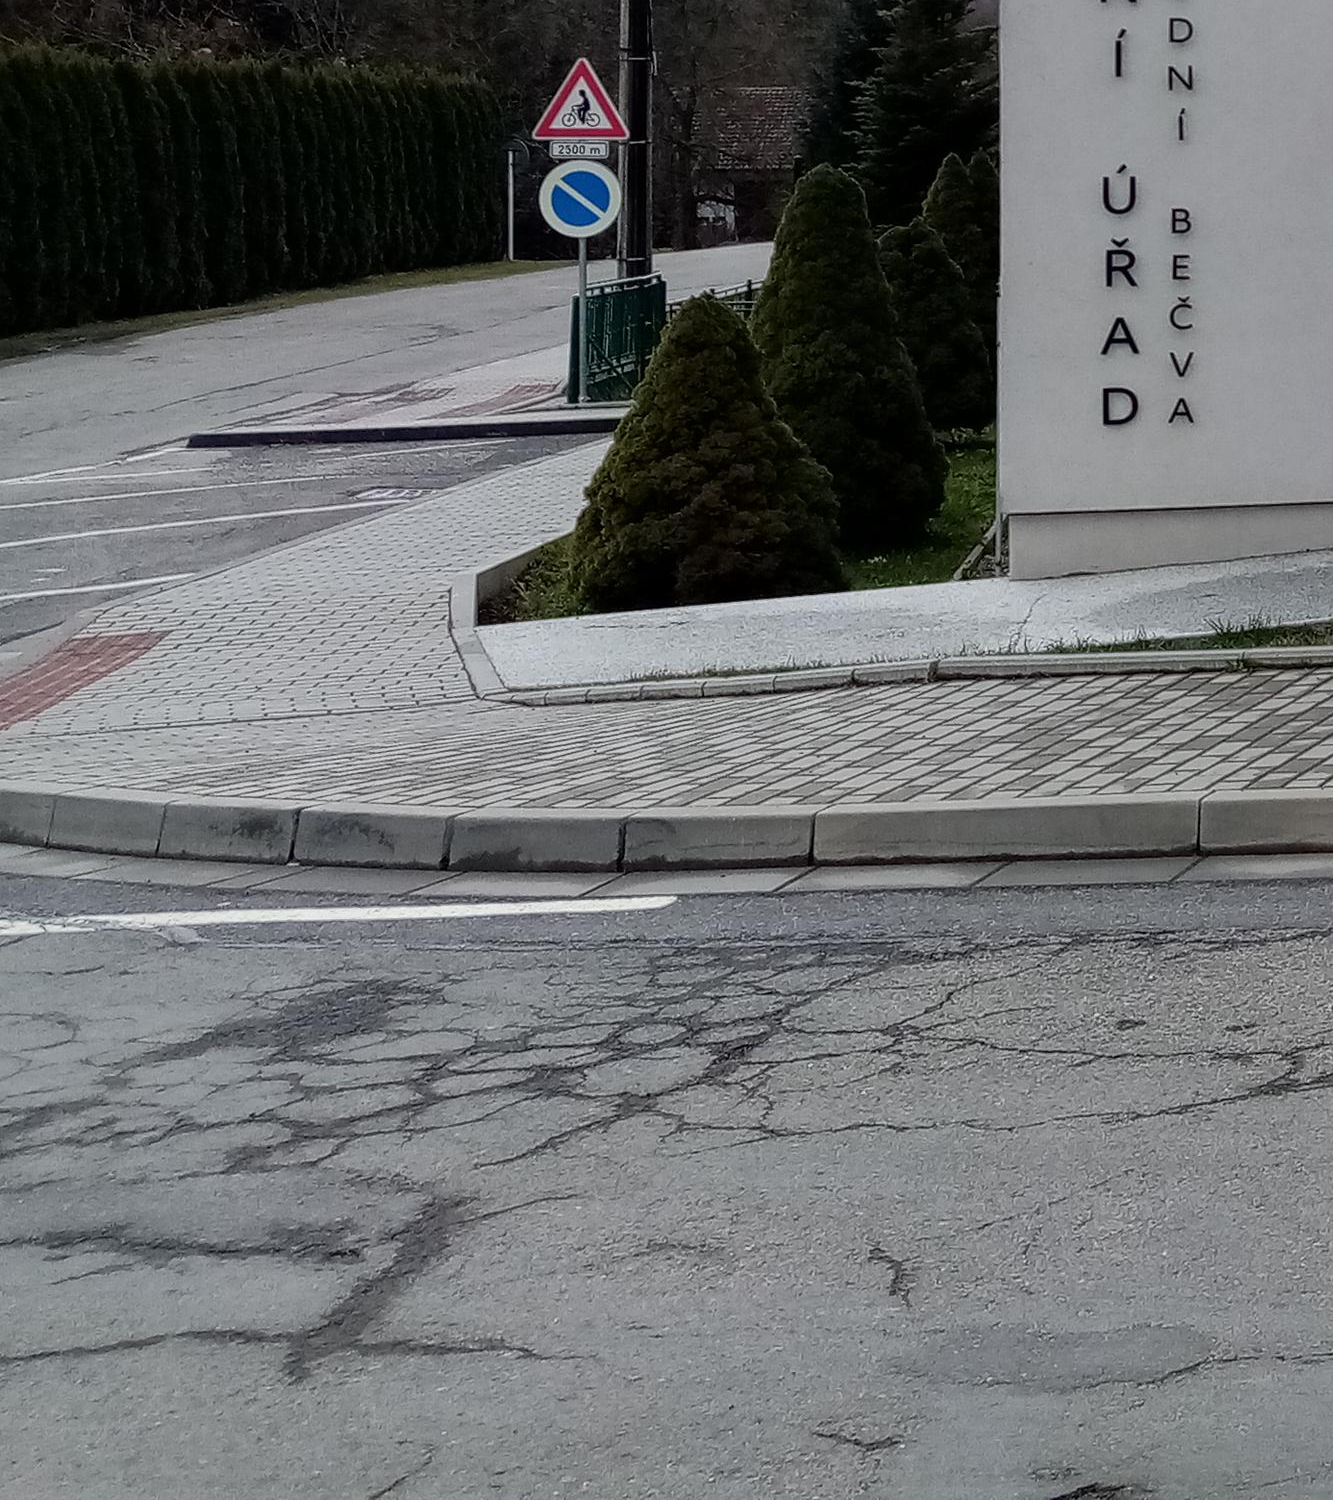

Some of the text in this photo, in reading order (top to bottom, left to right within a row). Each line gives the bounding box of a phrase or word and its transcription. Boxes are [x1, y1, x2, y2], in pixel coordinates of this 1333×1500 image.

[558, 144, 601, 155] 2500 m
[1101, 163, 1140, 426] ÚŘAD
[1167, 207, 1195, 424] BEČVA
